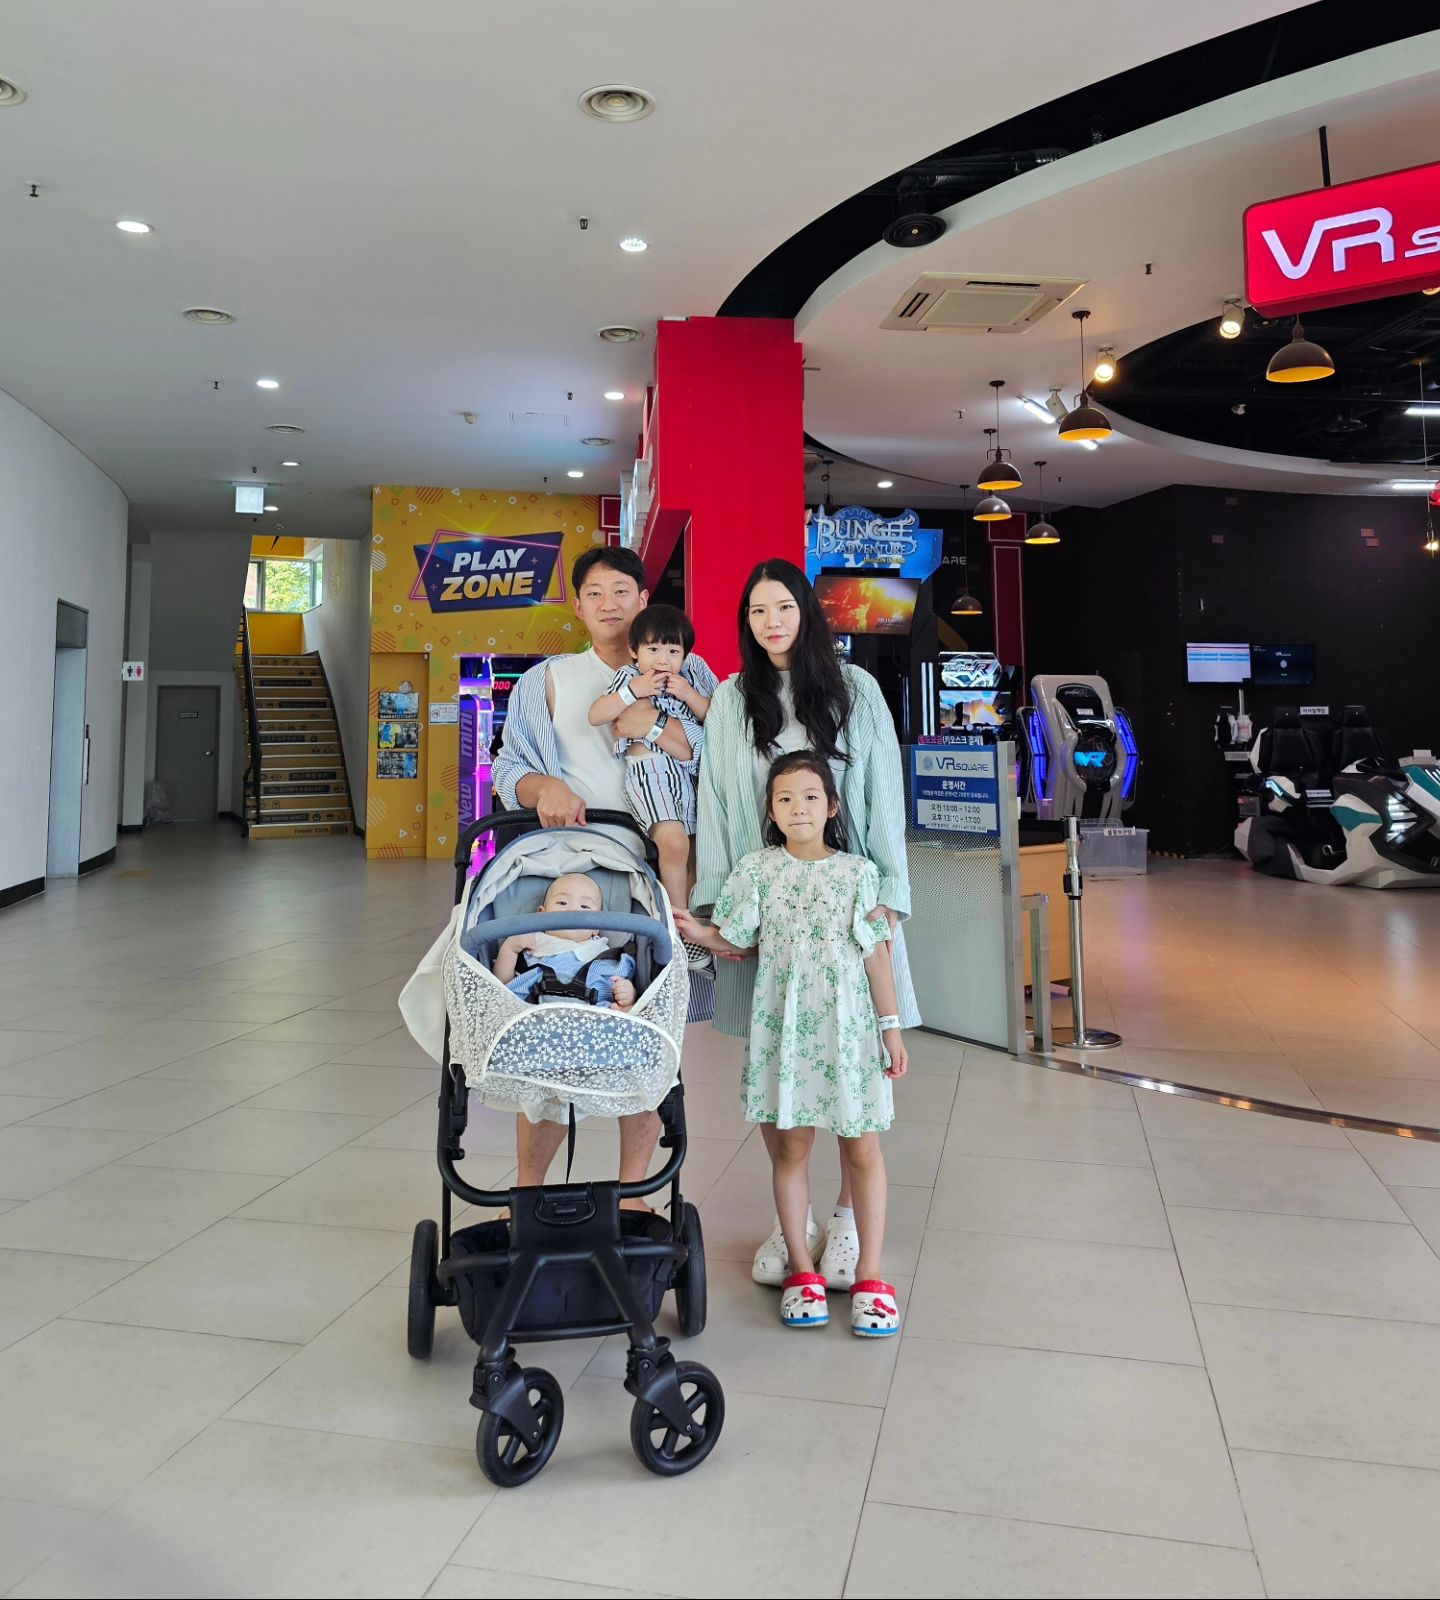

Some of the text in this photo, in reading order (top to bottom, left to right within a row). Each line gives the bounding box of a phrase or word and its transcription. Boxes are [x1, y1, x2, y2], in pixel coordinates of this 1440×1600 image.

[1261, 207, 1395, 280] VR
[814, 508, 915, 552] BUNGEE
[452, 547, 527, 573] PLAY
[838, 543, 906, 555] ADVENTURE
[440, 571, 535, 601] ZONE
[461, 712, 473, 757] mini
[942, 780, 966, 790] 운영시간
[459, 783, 472, 826] New
[931, 803, 942, 812] 오전
[943, 804, 958, 812] 10:00
[964, 805, 981, 814] 12:00
[932, 813, 942, 821] 오후
[964, 816, 981, 824] 17:00
